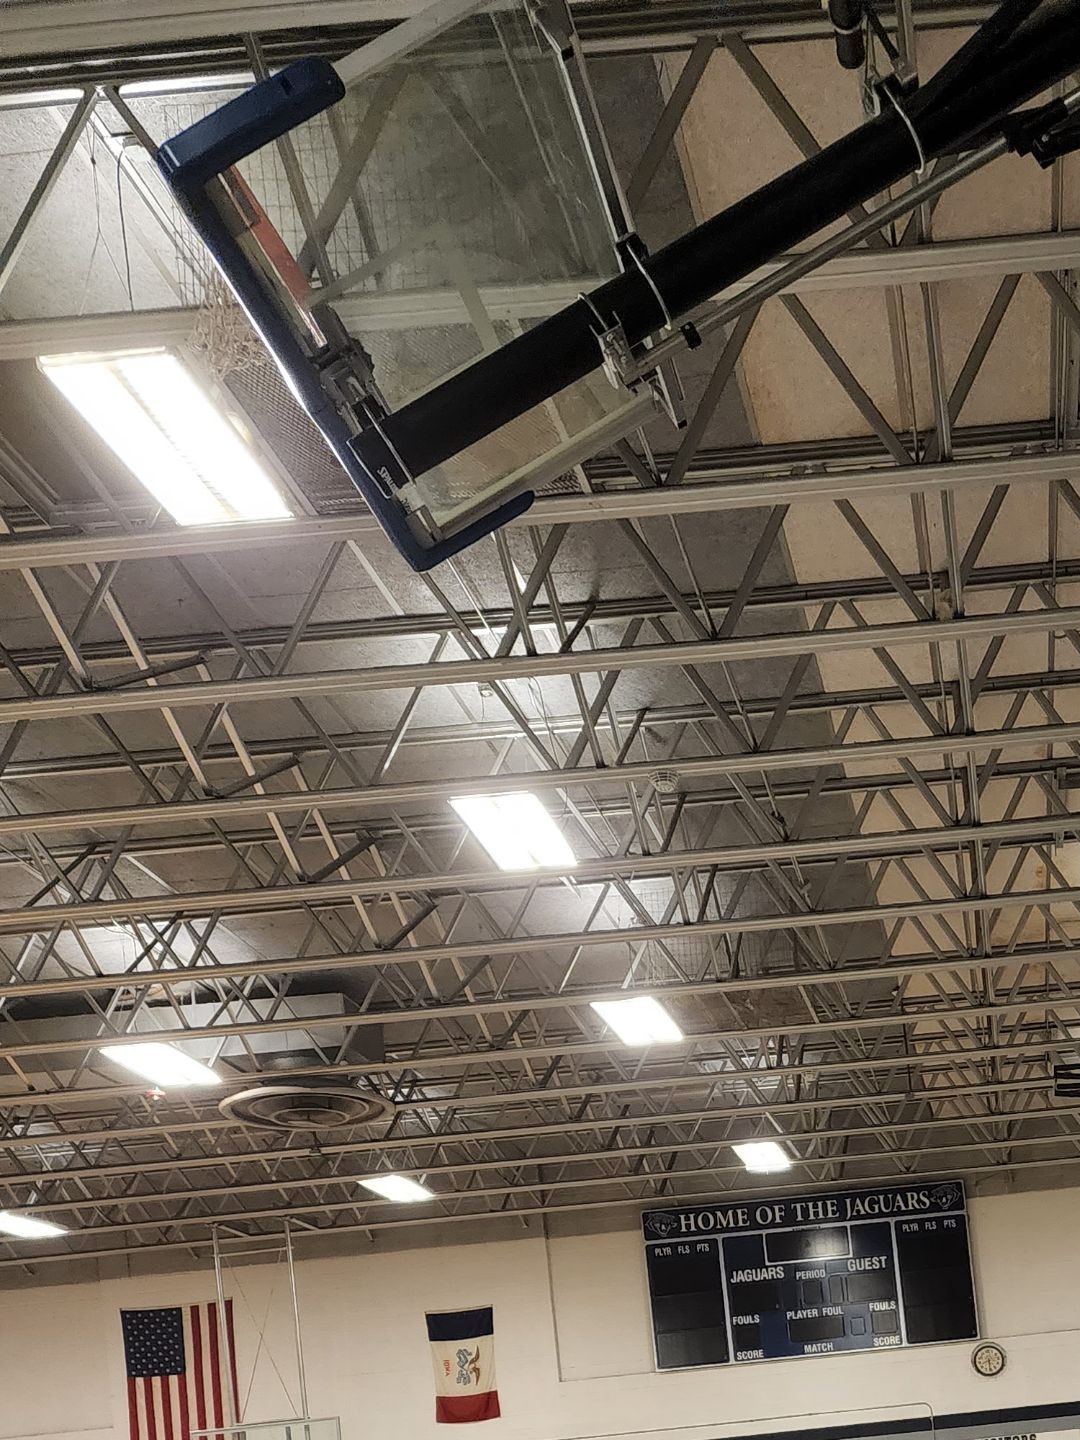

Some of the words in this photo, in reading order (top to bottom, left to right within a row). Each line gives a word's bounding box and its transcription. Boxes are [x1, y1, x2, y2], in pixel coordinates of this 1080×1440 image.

[678, 1208, 750, 1232] HOME
[755, 1204, 786, 1225] OF
[791, 1199, 840, 1221] THE
[846, 1190, 931, 1220] JAGUARS
[902, 1222, 919, 1232] PLYR
[925, 1221, 937, 1230] FLS
[943, 1219, 957, 1229] PTS
[654, 1246, 672, 1257] PLYR
[677, 1245, 690, 1254] FLS
[696, 1243, 710, 1253] PTS
[847, 1256, 888, 1271] GUEST
[730, 1266, 785, 1284] JAGUARS
[795, 1269, 826, 1280] PERIOD
[868, 1301, 896, 1311] FOULS
[786, 1308, 819, 1320] PLAYER
[822, 1306, 844, 1316] FOUL
[732, 1314, 760, 1326] FOULS
[873, 1335, 901, 1347] SCORE
[803, 1342, 834, 1354] MATCH
[736, 1349, 764, 1361] SCORE
